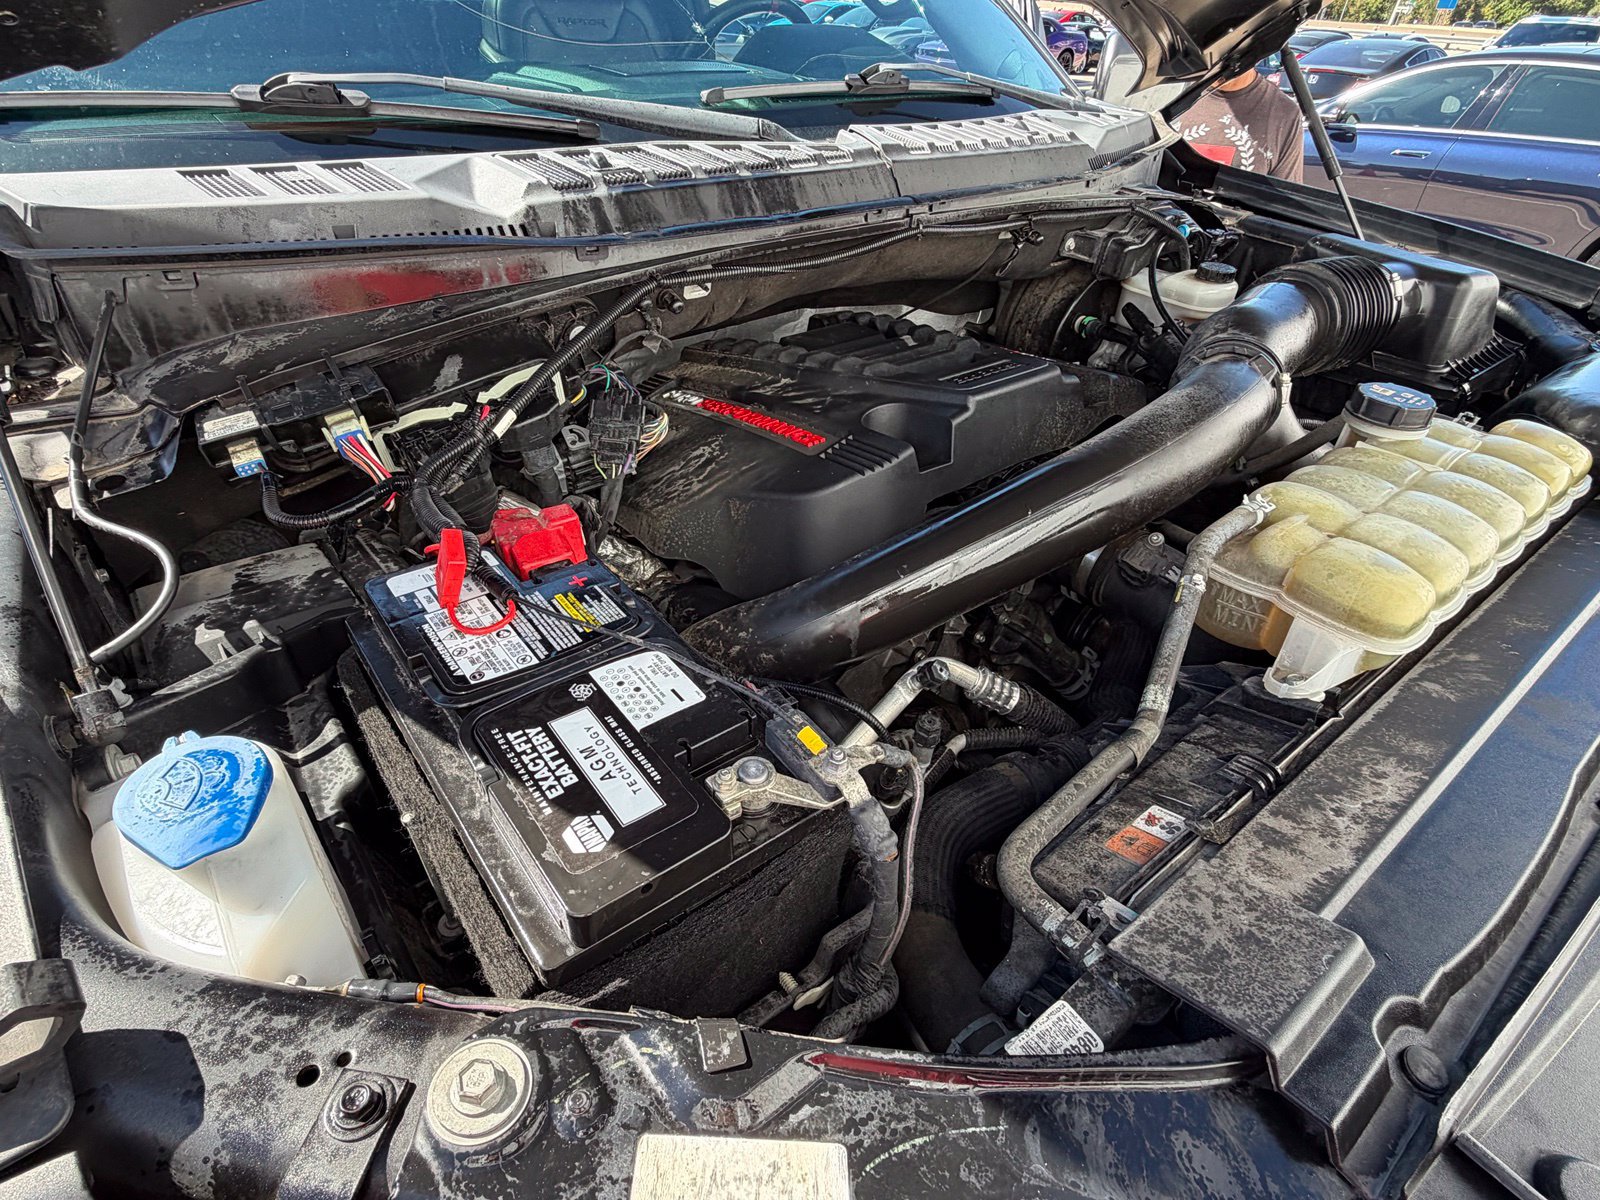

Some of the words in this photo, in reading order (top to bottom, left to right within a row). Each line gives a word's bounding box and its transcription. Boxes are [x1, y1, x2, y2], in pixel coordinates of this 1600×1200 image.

[1214, 604, 1260, 633] MIN
[1220, 585, 1264, 614] MAX
[604, 715, 620, 729] MAT
[614, 728, 635, 748] GLASS
[491, 728, 553, 816] MAINTENANCE-FREE
[506, 729, 565, 800] EXACT-FIT
[525, 726, 579, 788] BATTERY
[584, 725, 642, 796] TECHNOLOGY
